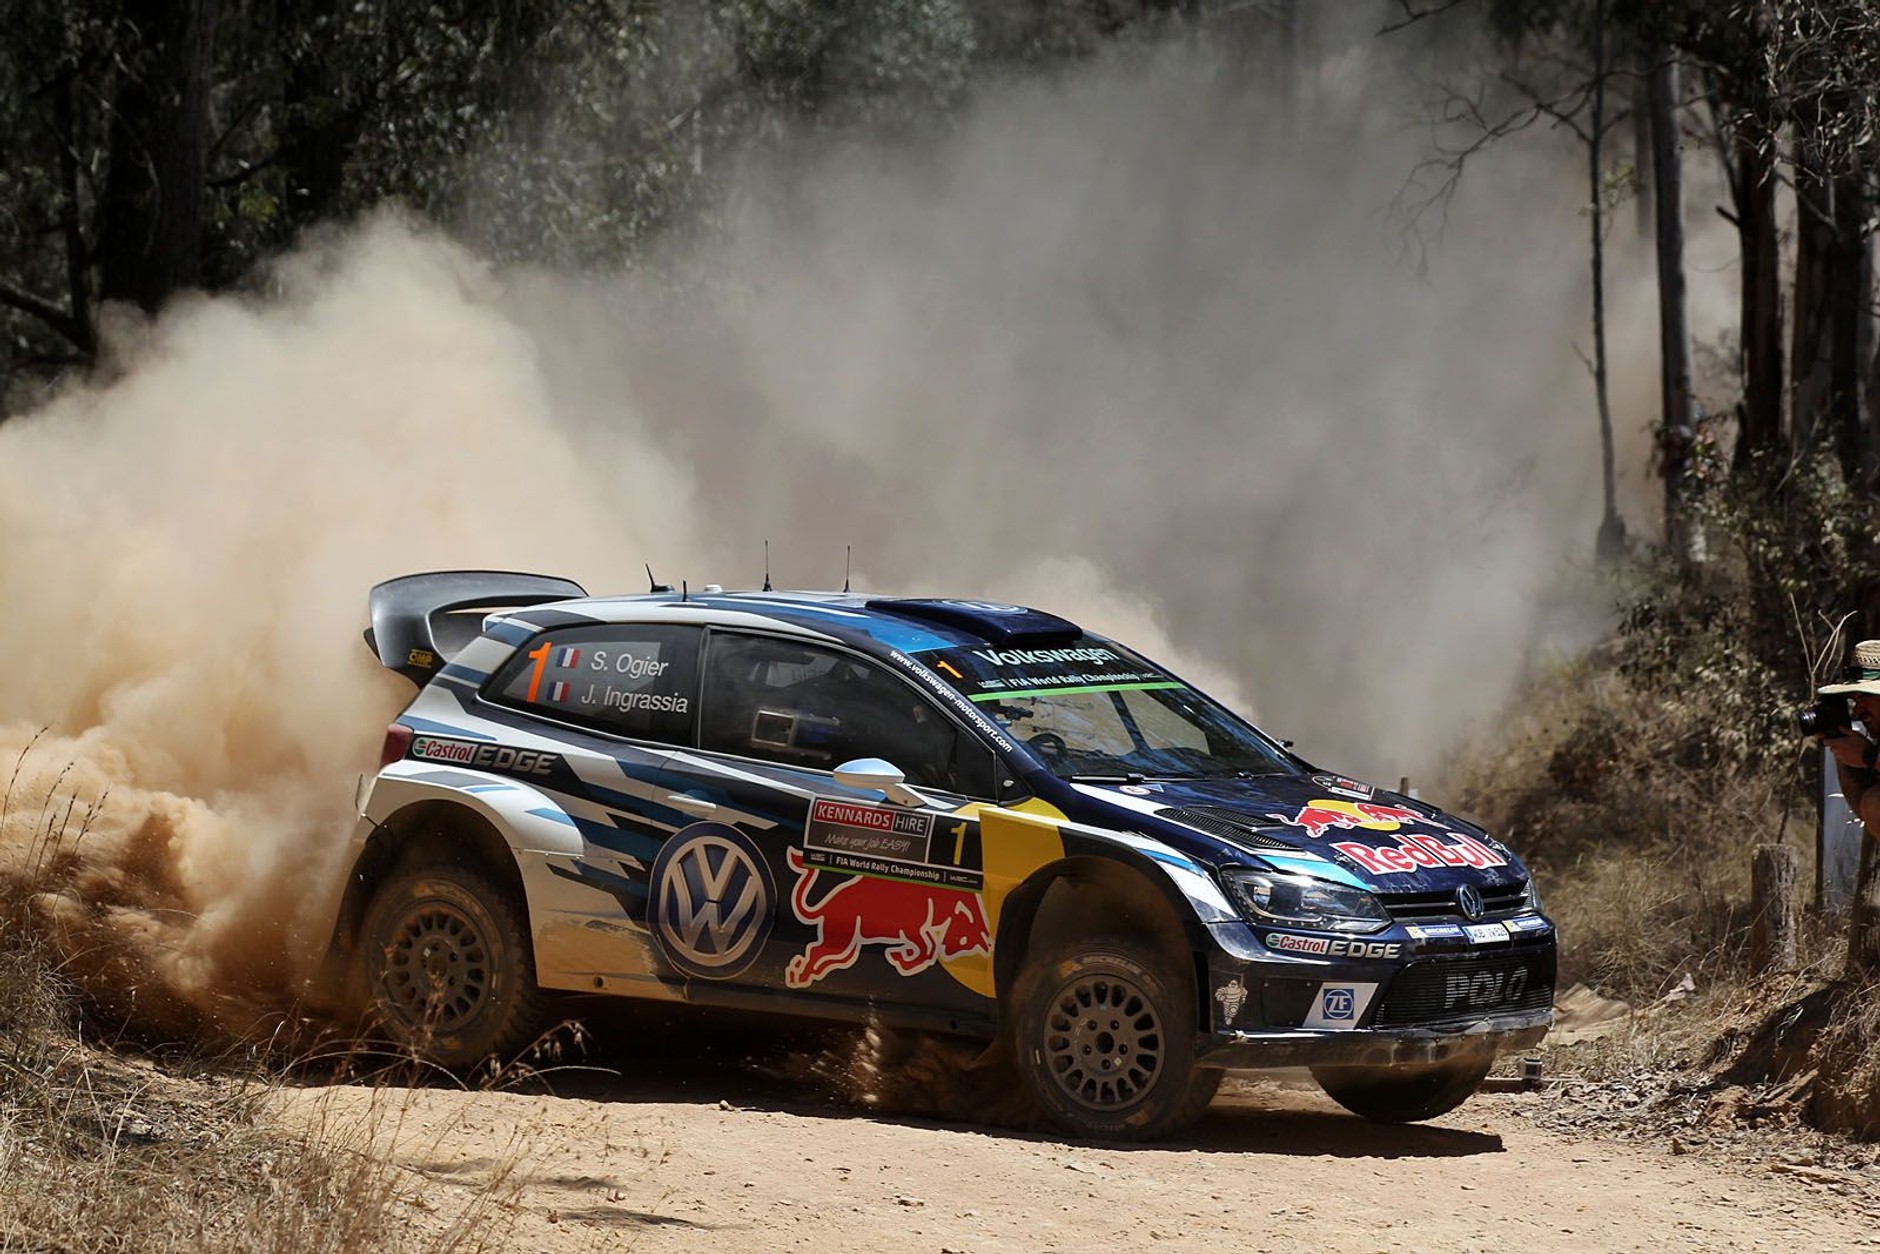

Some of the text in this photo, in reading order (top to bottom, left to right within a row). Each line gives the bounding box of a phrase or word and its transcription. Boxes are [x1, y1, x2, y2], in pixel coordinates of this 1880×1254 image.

[528, 641, 553, 703] 1
[591, 651, 668, 680] S. Ogier
[936, 660, 963, 679] 1
[972, 648, 1119, 667] Volkswagen
[1008, 678, 1031, 688] FIA
[1029, 676, 1059, 687] World
[1058, 674, 1086, 687] Rally
[1083, 672, 1140, 684] Championship
[581, 684, 688, 714] J. Ingrassia
[889, 649, 1013, 753] www.volkswagen-motorsport.com
[425, 741, 558, 775] Castrol EDGE
[817, 804, 925, 833] KENNARDS HIRE
[824, 834, 847, 845] Make
[850, 838, 866, 848] your
[864, 839, 881, 850] job
[951, 822, 968, 866] 1
[836, 856, 849, 866] FIA
[850, 858, 870, 870] World
[871, 861, 890, 874] Rally
[890, 865, 940, 880] Championship
[1279, 934, 1401, 960] Castrol EDGE
[1326, 993, 1349, 1012] ZF
[1444, 967, 1528, 1009] POLO
